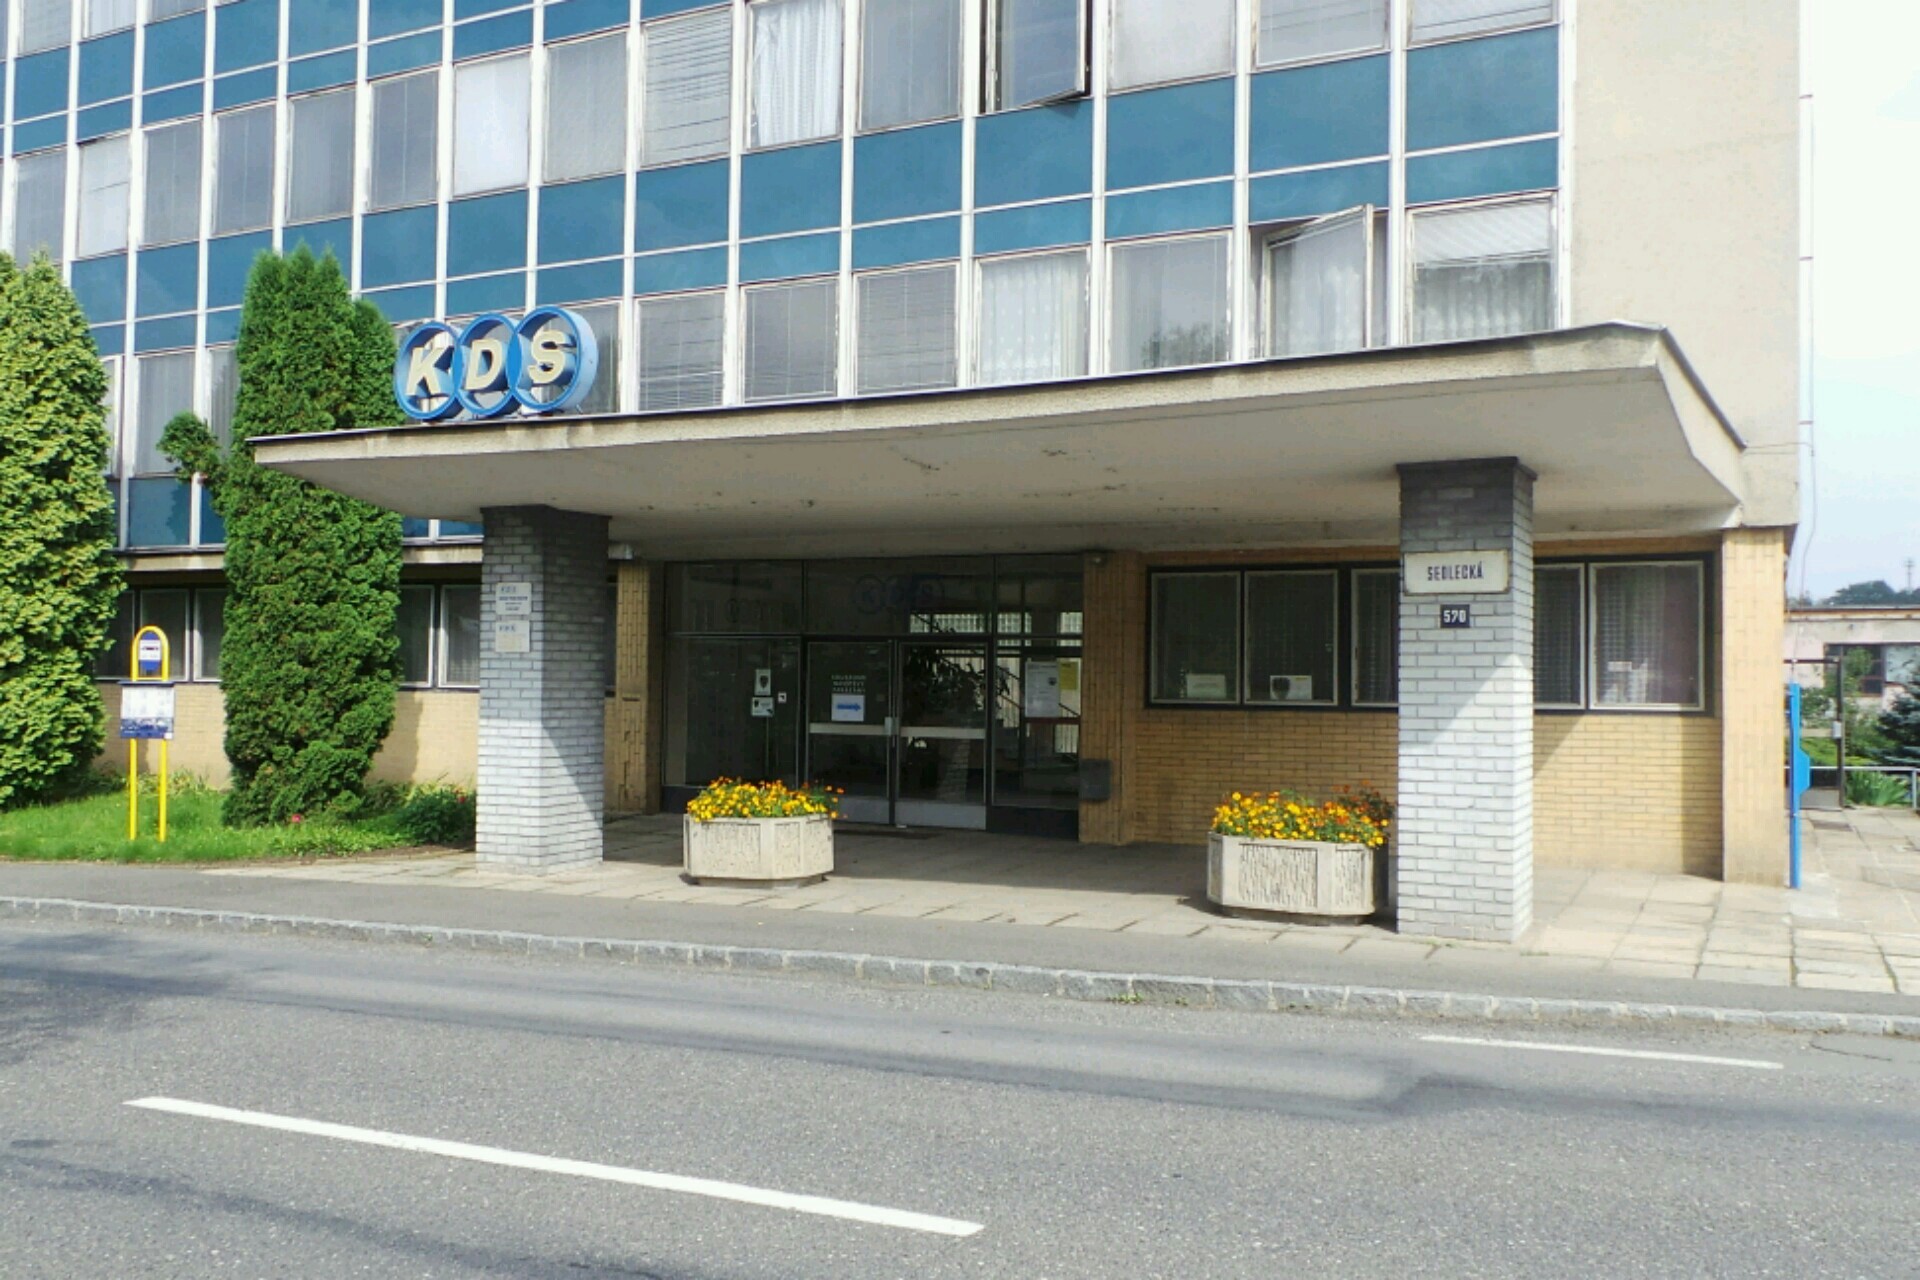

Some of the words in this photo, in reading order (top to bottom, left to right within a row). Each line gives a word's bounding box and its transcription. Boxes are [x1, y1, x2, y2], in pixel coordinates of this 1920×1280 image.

[405, 329, 567, 396] KDS
[1427, 561, 1484, 581] SEDLECKÁ
[1443, 609, 1467, 623] 570
